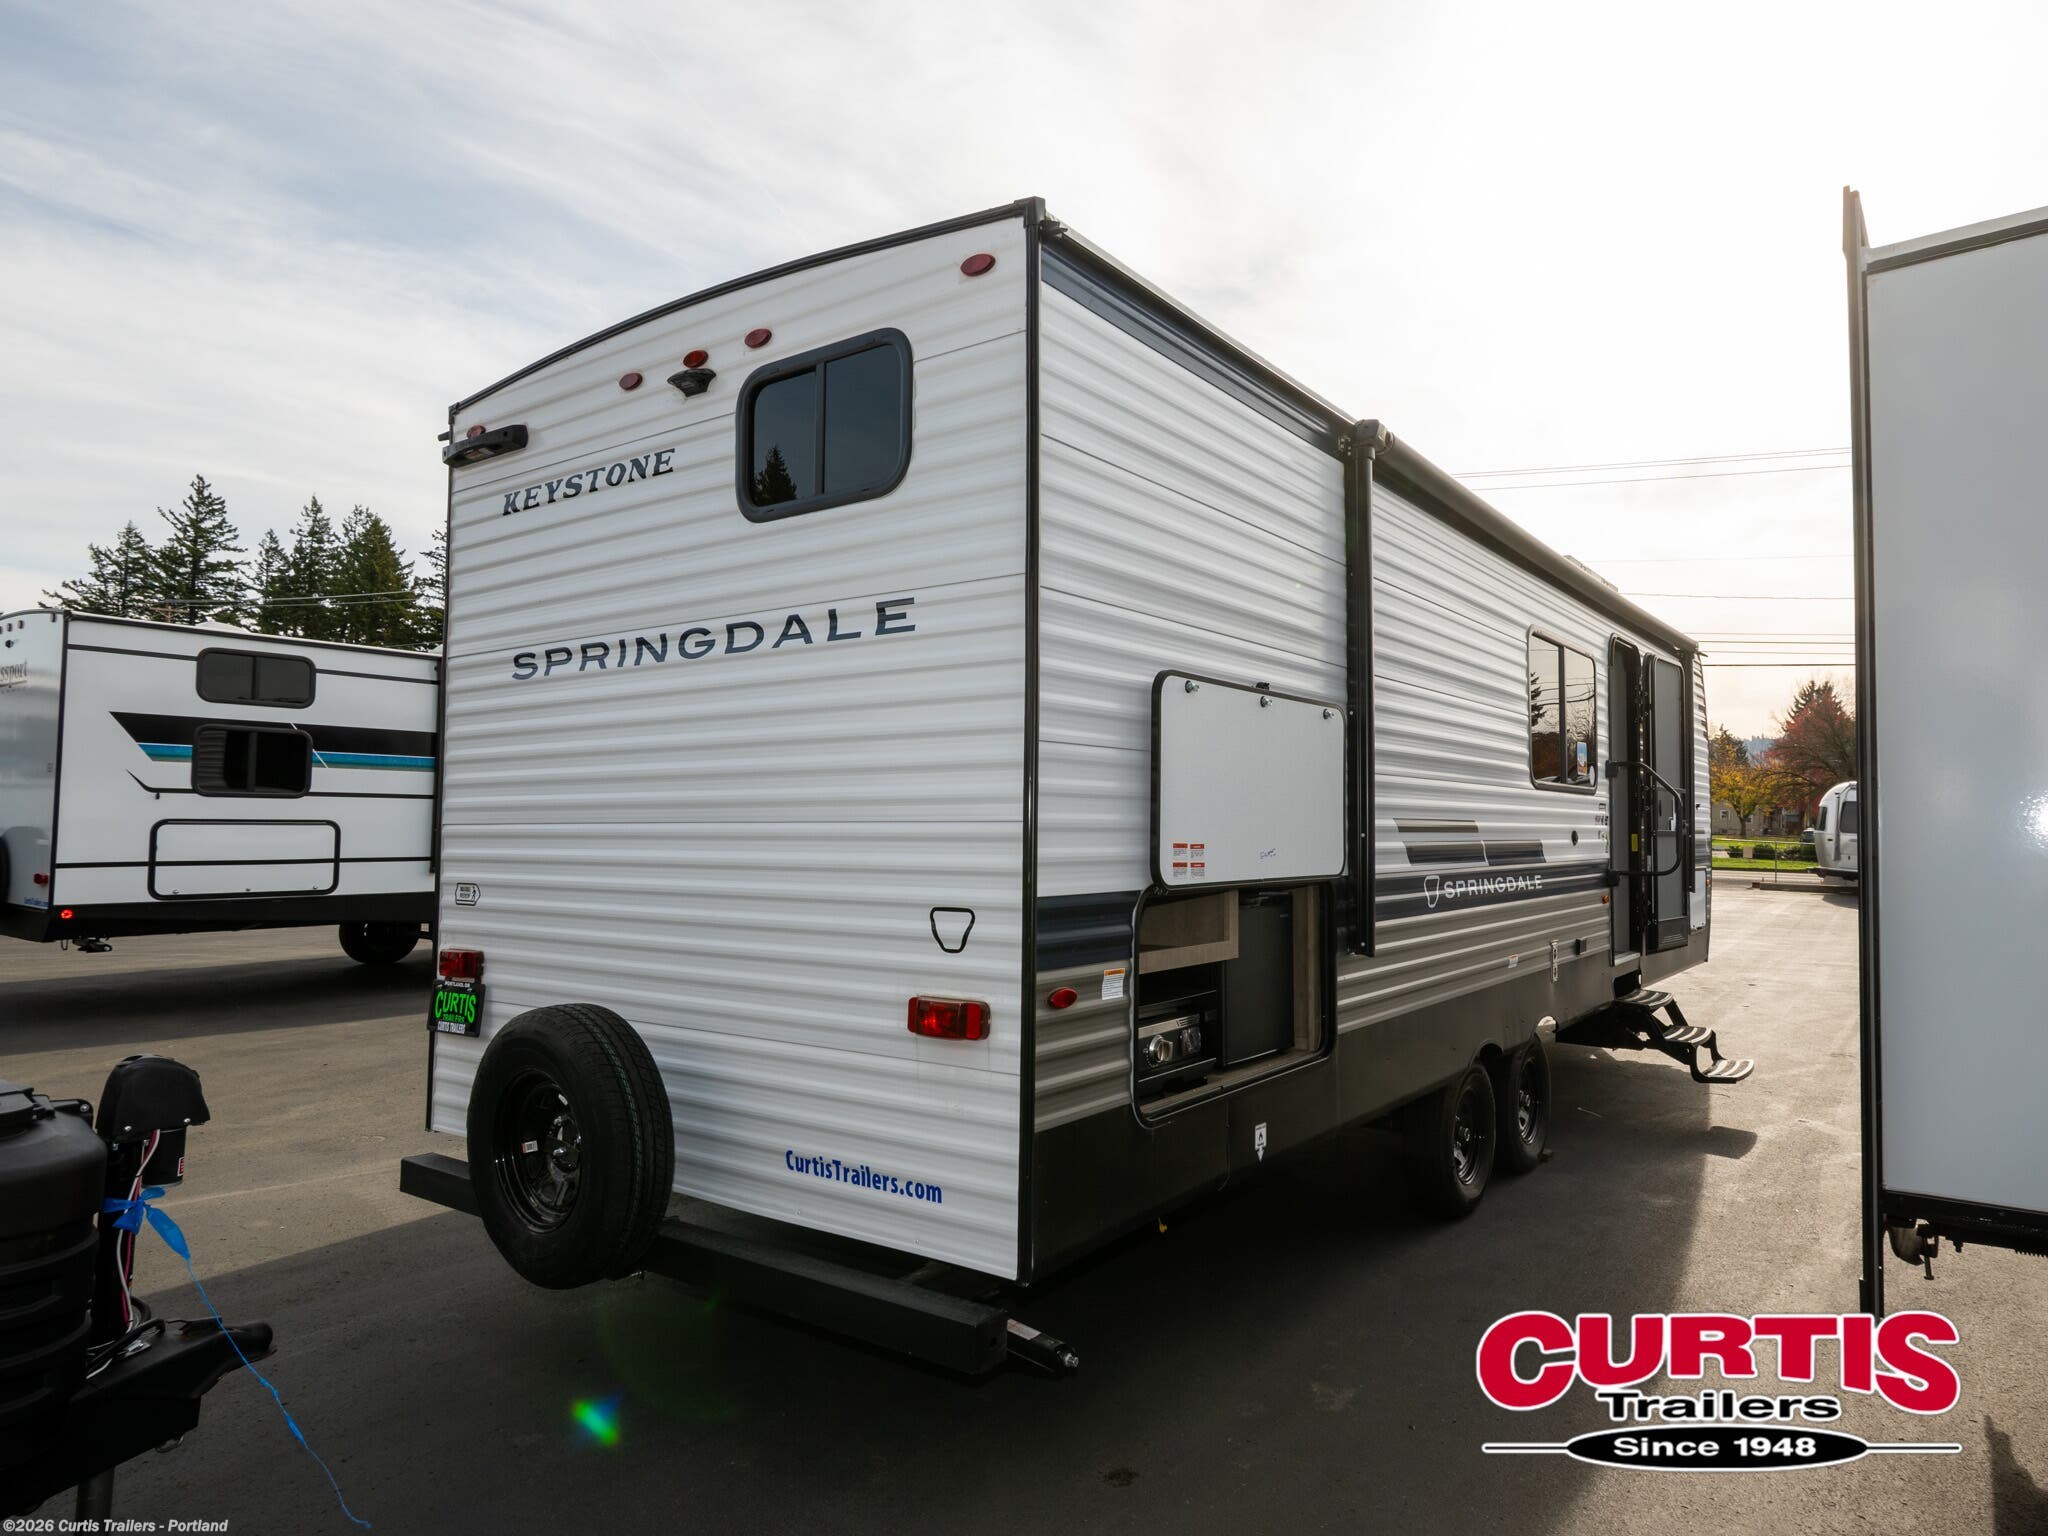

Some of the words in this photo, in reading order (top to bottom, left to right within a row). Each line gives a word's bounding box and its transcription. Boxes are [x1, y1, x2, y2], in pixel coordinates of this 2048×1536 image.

[503, 448, 675, 516] KEYSTONE
[512, 597, 916, 680] SPRINGDALE
[1443, 875, 1543, 899] SPRINGDALE
[435, 991, 476, 1023] CURTIS
[438, 1021, 450, 1032] CURTIS
[450, 1023, 466, 1034] TRAILERS
[785, 1150, 942, 1204] CurtisTrailers.com
